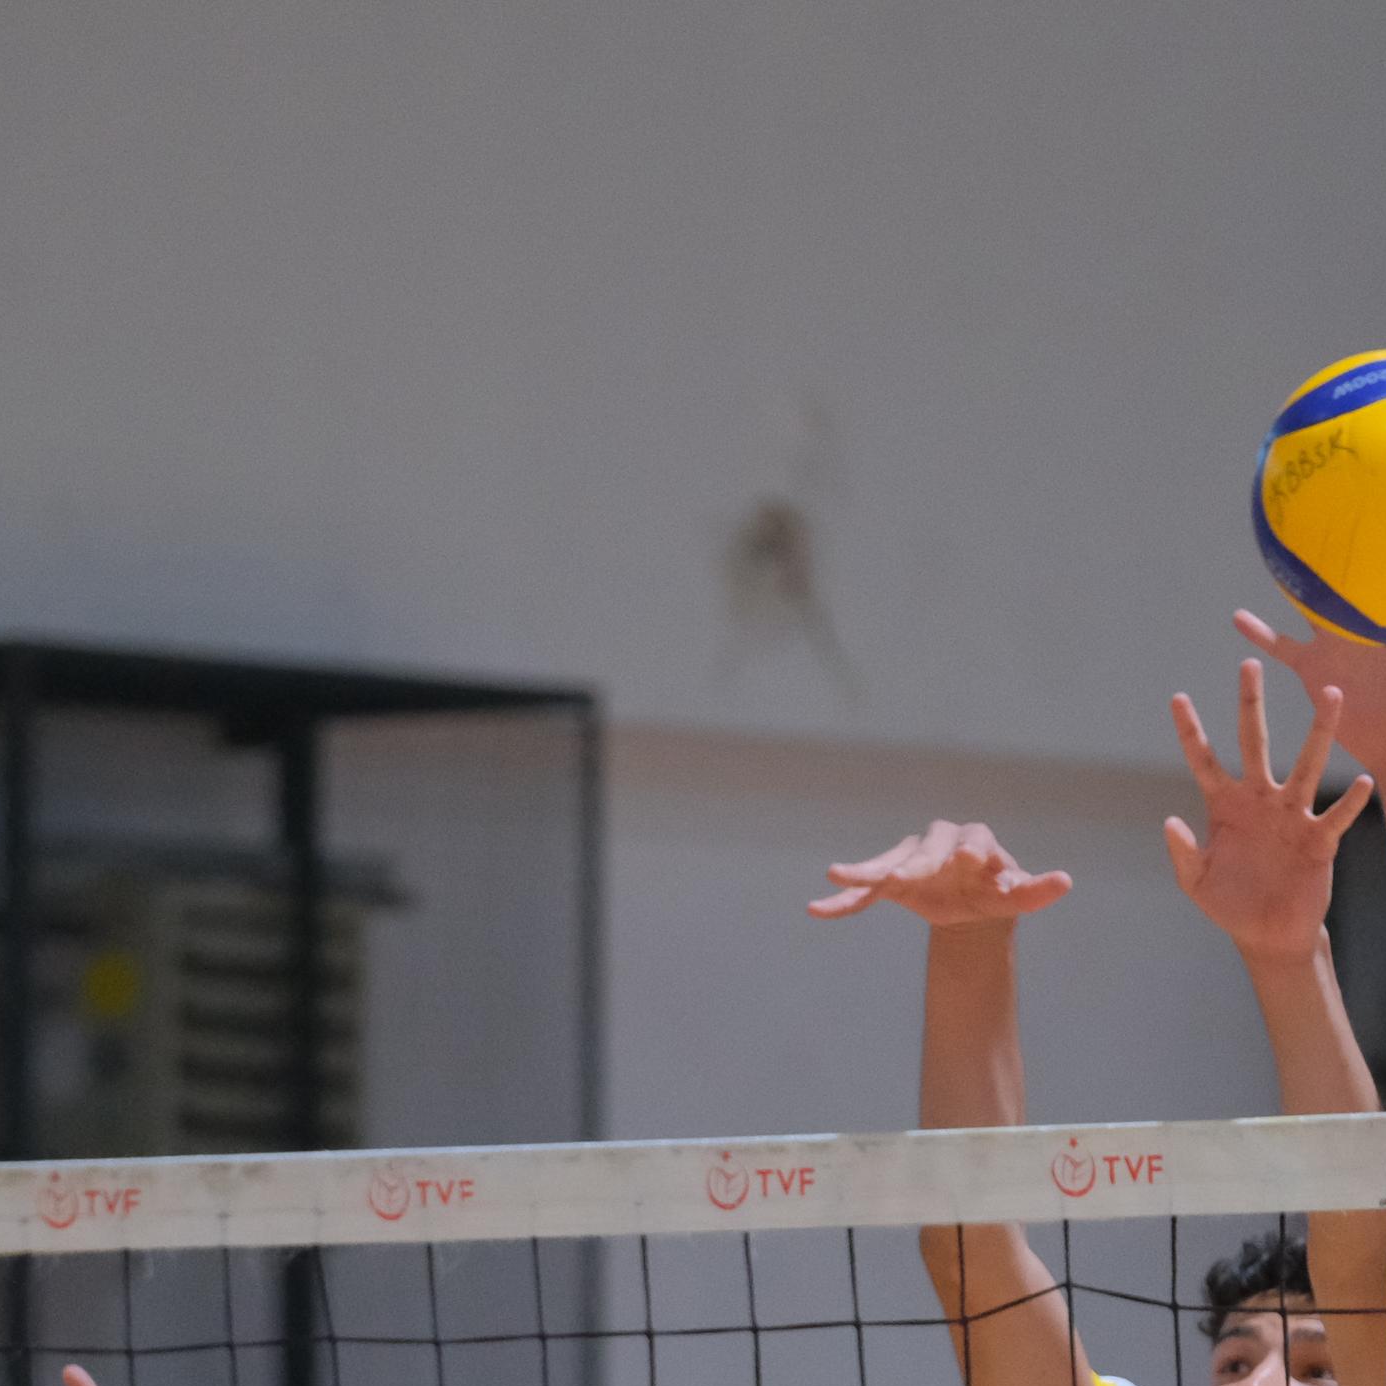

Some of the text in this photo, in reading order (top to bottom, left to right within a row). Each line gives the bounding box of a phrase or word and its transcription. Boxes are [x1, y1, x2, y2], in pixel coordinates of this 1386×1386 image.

[755, 1166, 818, 1197] TVF
[1103, 1153, 1164, 1186] TVF
[84, 1188, 141, 1217] TVF
[415, 1178, 476, 1207] TVF
